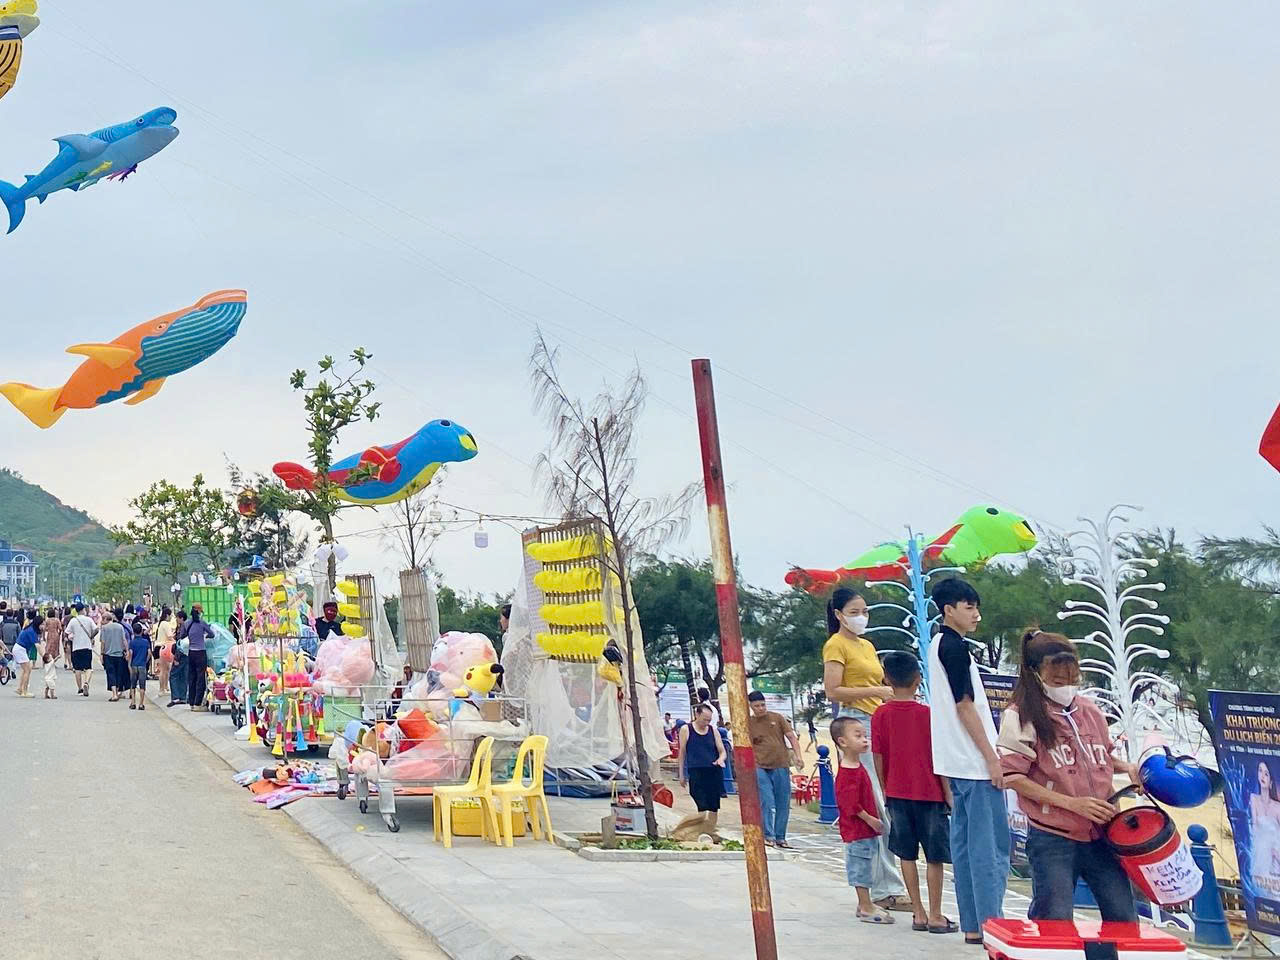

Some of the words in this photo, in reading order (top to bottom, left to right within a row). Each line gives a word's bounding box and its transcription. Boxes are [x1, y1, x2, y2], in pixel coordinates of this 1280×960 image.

[1225, 714, 1247, 729] KHAI
[1223, 729, 1235, 740] DU
[1235, 730, 1254, 744] LỊCH
